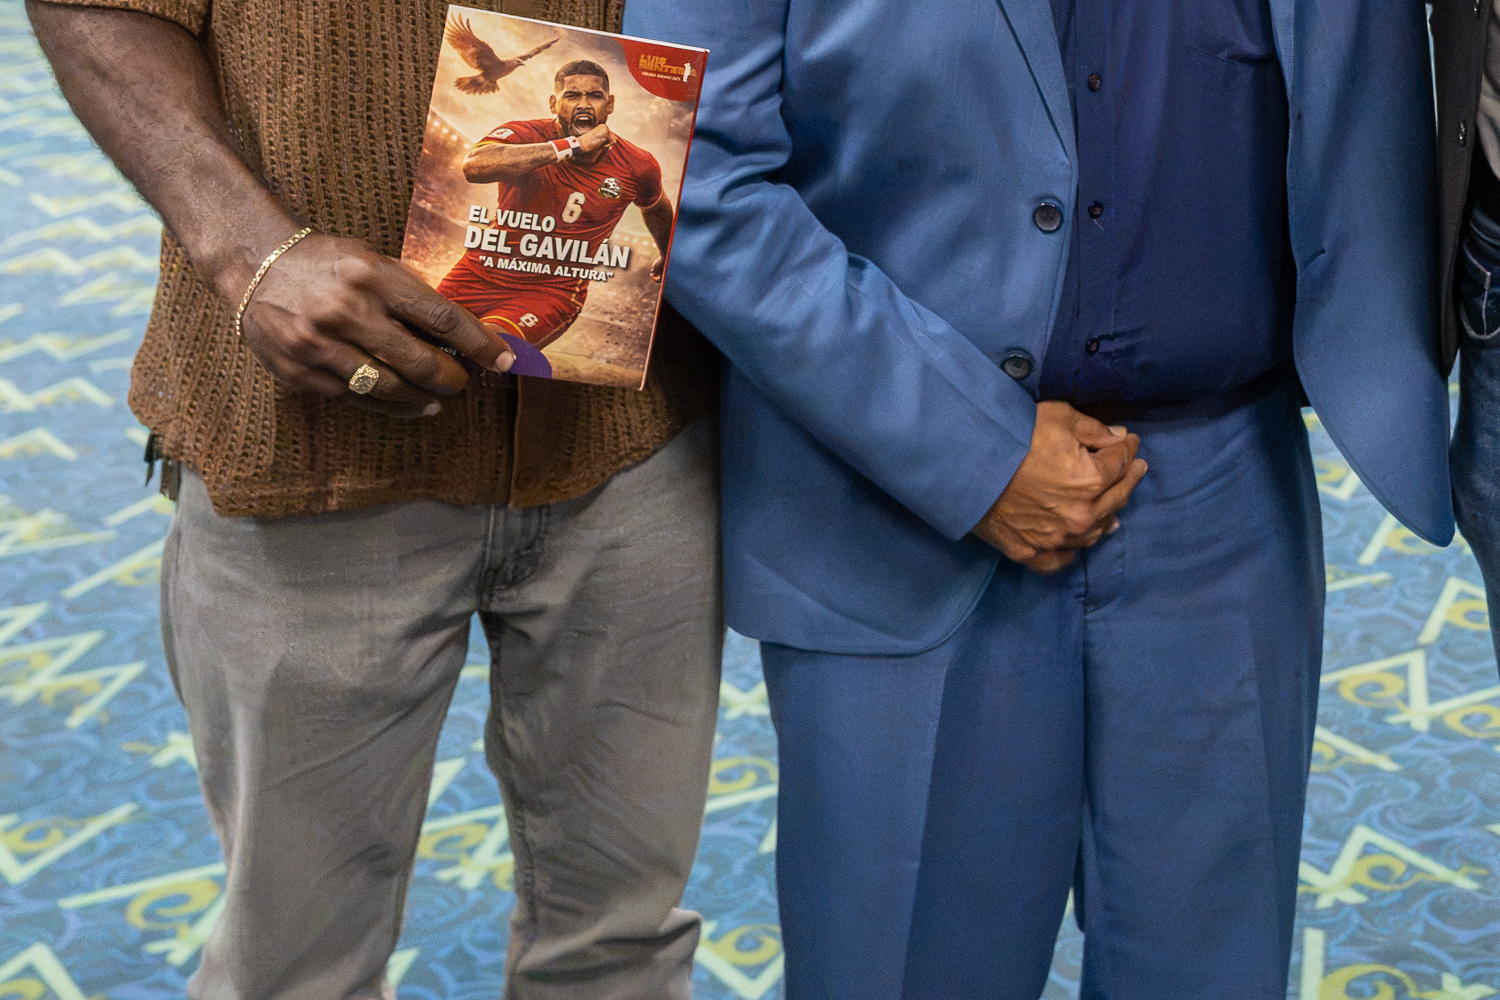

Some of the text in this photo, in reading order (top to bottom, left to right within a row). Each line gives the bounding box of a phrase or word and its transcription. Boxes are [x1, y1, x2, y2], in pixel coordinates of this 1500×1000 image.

[469, 205, 556, 233] EL VUELO
[561, 191, 586, 224] 6
[464, 225, 630, 268] DEL GAVILÁN
[497, 257, 551, 275] MÁXIMA
[553, 265, 614, 281] ALTURA"
